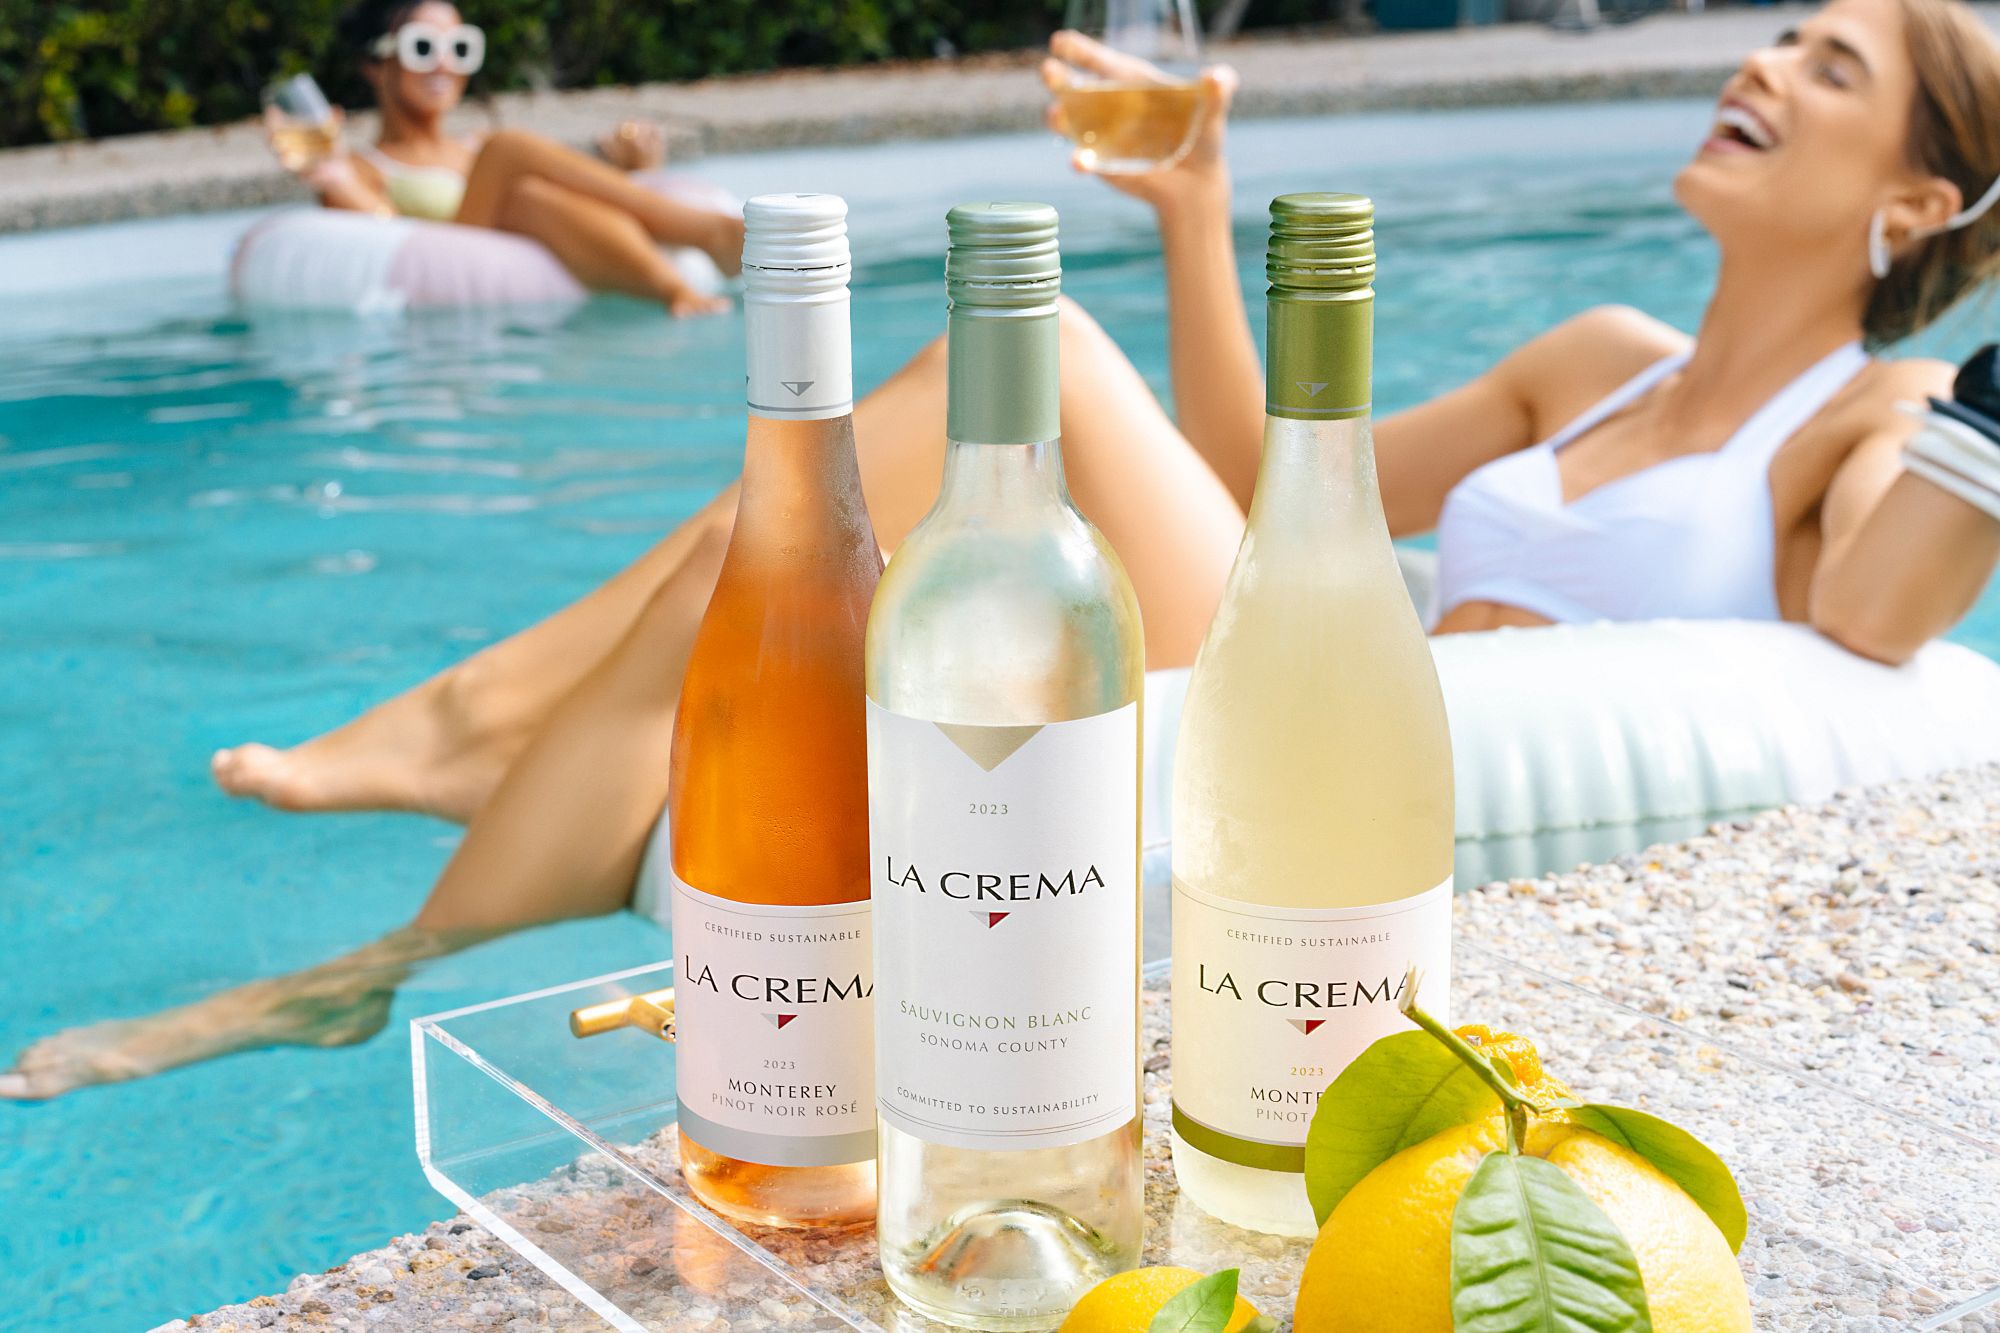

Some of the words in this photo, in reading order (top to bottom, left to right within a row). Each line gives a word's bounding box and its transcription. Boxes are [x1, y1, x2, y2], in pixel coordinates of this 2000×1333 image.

[968, 803, 1009, 815] 2023
[887, 856, 926, 893] LA
[940, 864, 1105, 901] CREMA
[704, 922, 762, 941] CERTIFIED
[770, 930, 861, 943] SUSTAINABLE
[1227, 929, 1293, 946] CERTIFIED
[1301, 932, 1391, 947] SUSTAINABLE
[685, 954, 719, 992] LA
[731, 974, 873, 1003] CREM
[1200, 964, 1242, 1000] LA
[900, 1000, 1016, 1029] SAUVIGNON
[1028, 1006, 1092, 1029] BLANC
[920, 1033, 989, 1052] SONOMA
[998, 1037, 1068, 1053] COUNTY
[763, 1059, 796, 1070] 2023
[1291, 1067, 1324, 1076] 2023
[729, 1078, 836, 1098] MONTEREY
[712, 1093, 755, 1113] PINOT
[764, 1104, 806, 1116] NOIR
[816, 1100, 857, 1116] ROSÉ
[897, 1086, 962, 1112] COMMITTED
[969, 1105, 985, 1114] TO
[993, 1094, 1099, 1115] SUSTAINABILITY
[1257, 1109, 1308, 1123] PINOT
